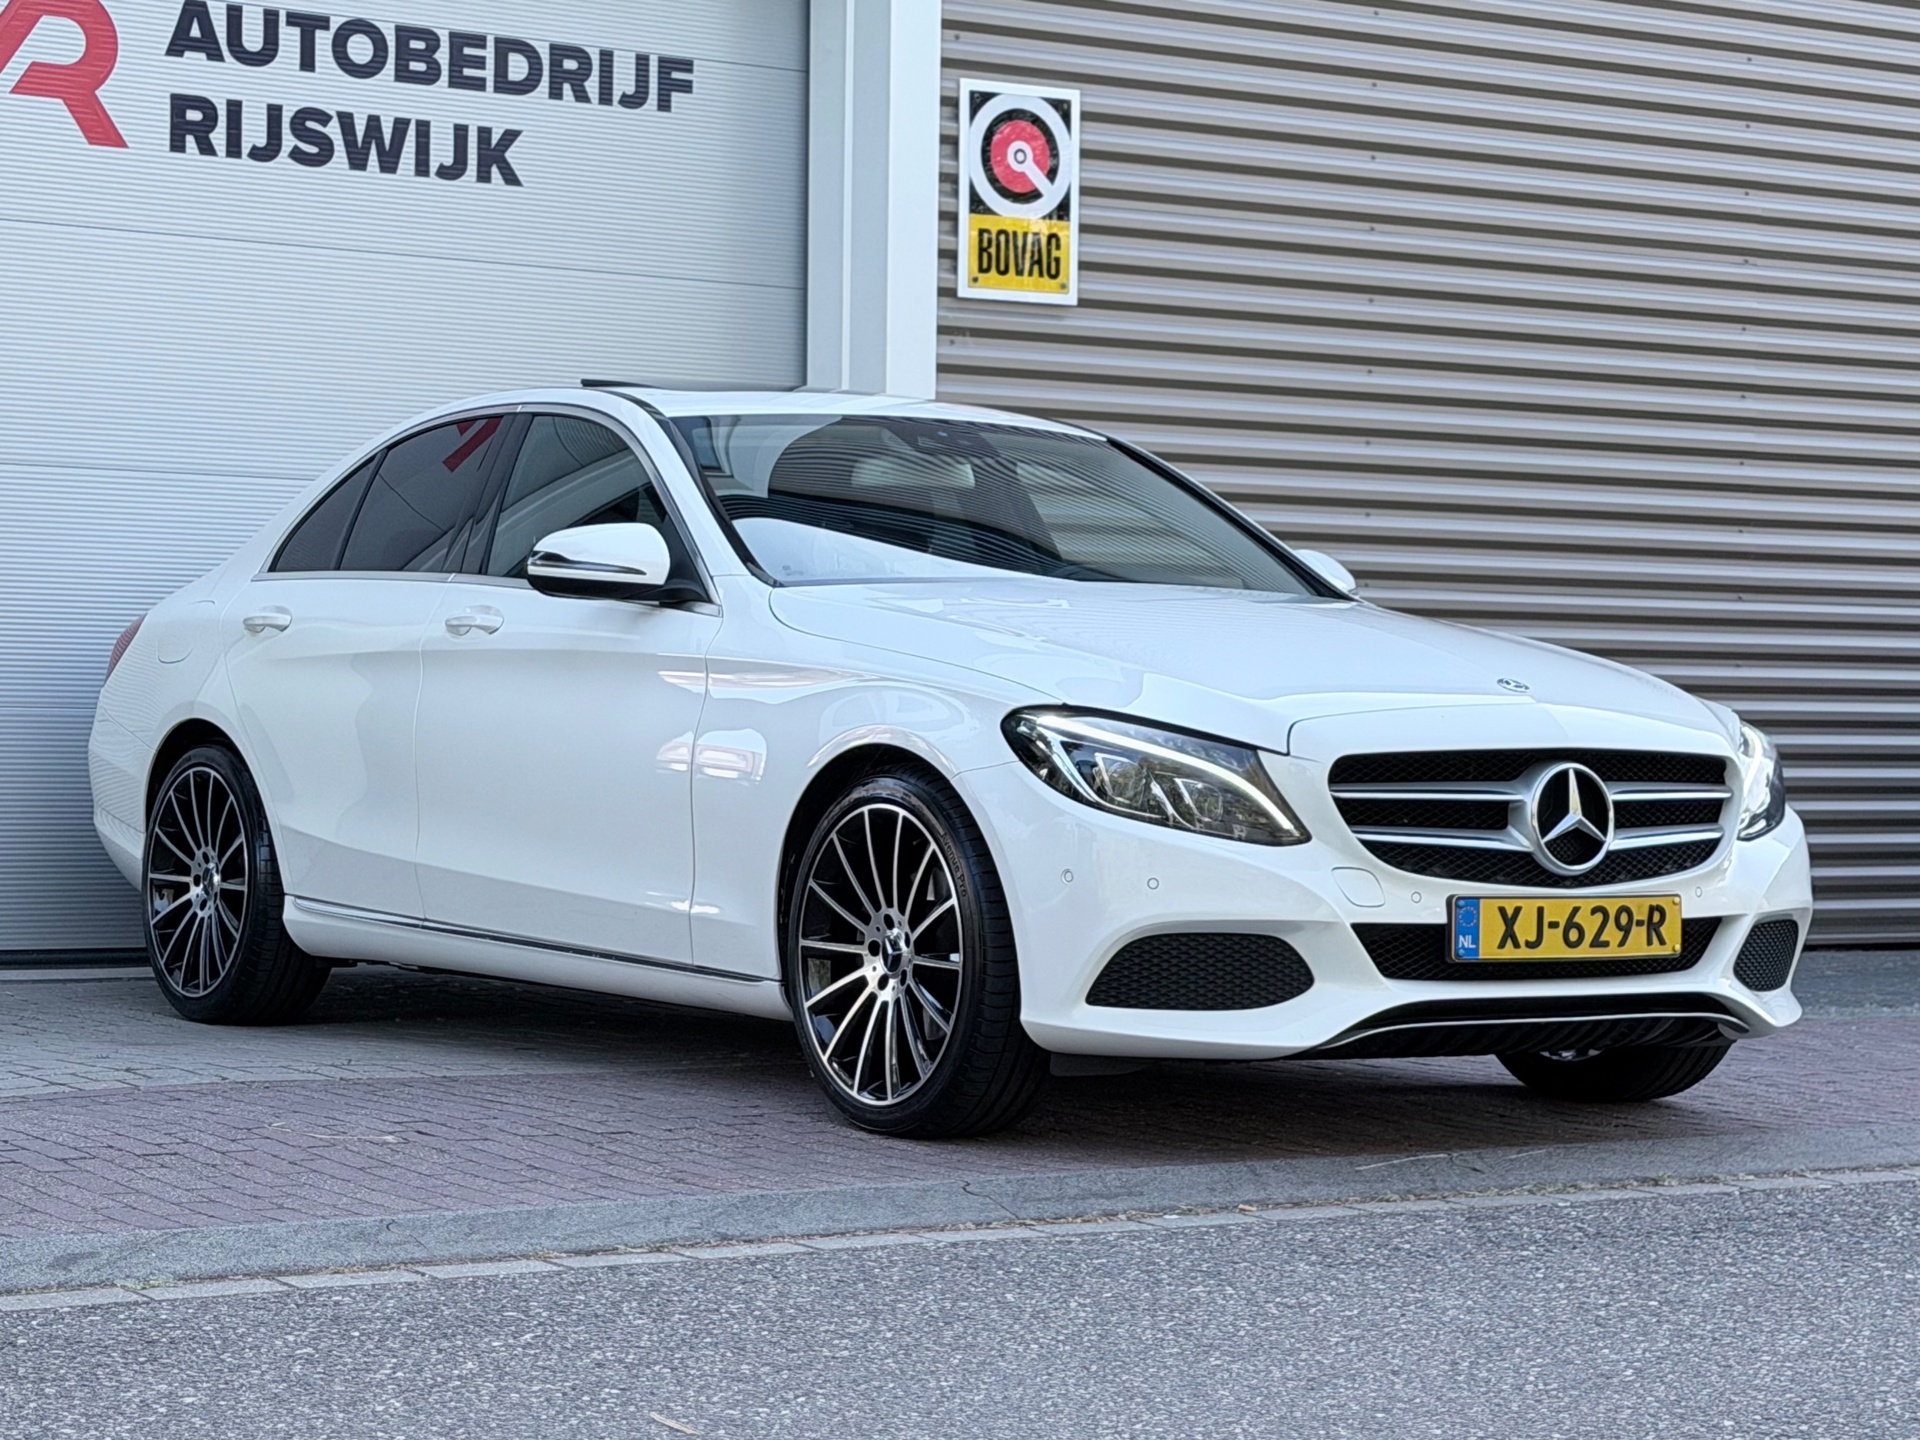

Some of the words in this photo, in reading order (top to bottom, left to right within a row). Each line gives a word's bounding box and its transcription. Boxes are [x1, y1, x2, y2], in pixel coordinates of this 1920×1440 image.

[165, 0, 694, 113] AUTOBEDRIJF
[169, 93, 524, 187] RIJSWIJK
[978, 228, 1061, 280] BOVAG
[1459, 935, 1476, 948] NL
[1497, 904, 1667, 949] XJ-629-R
